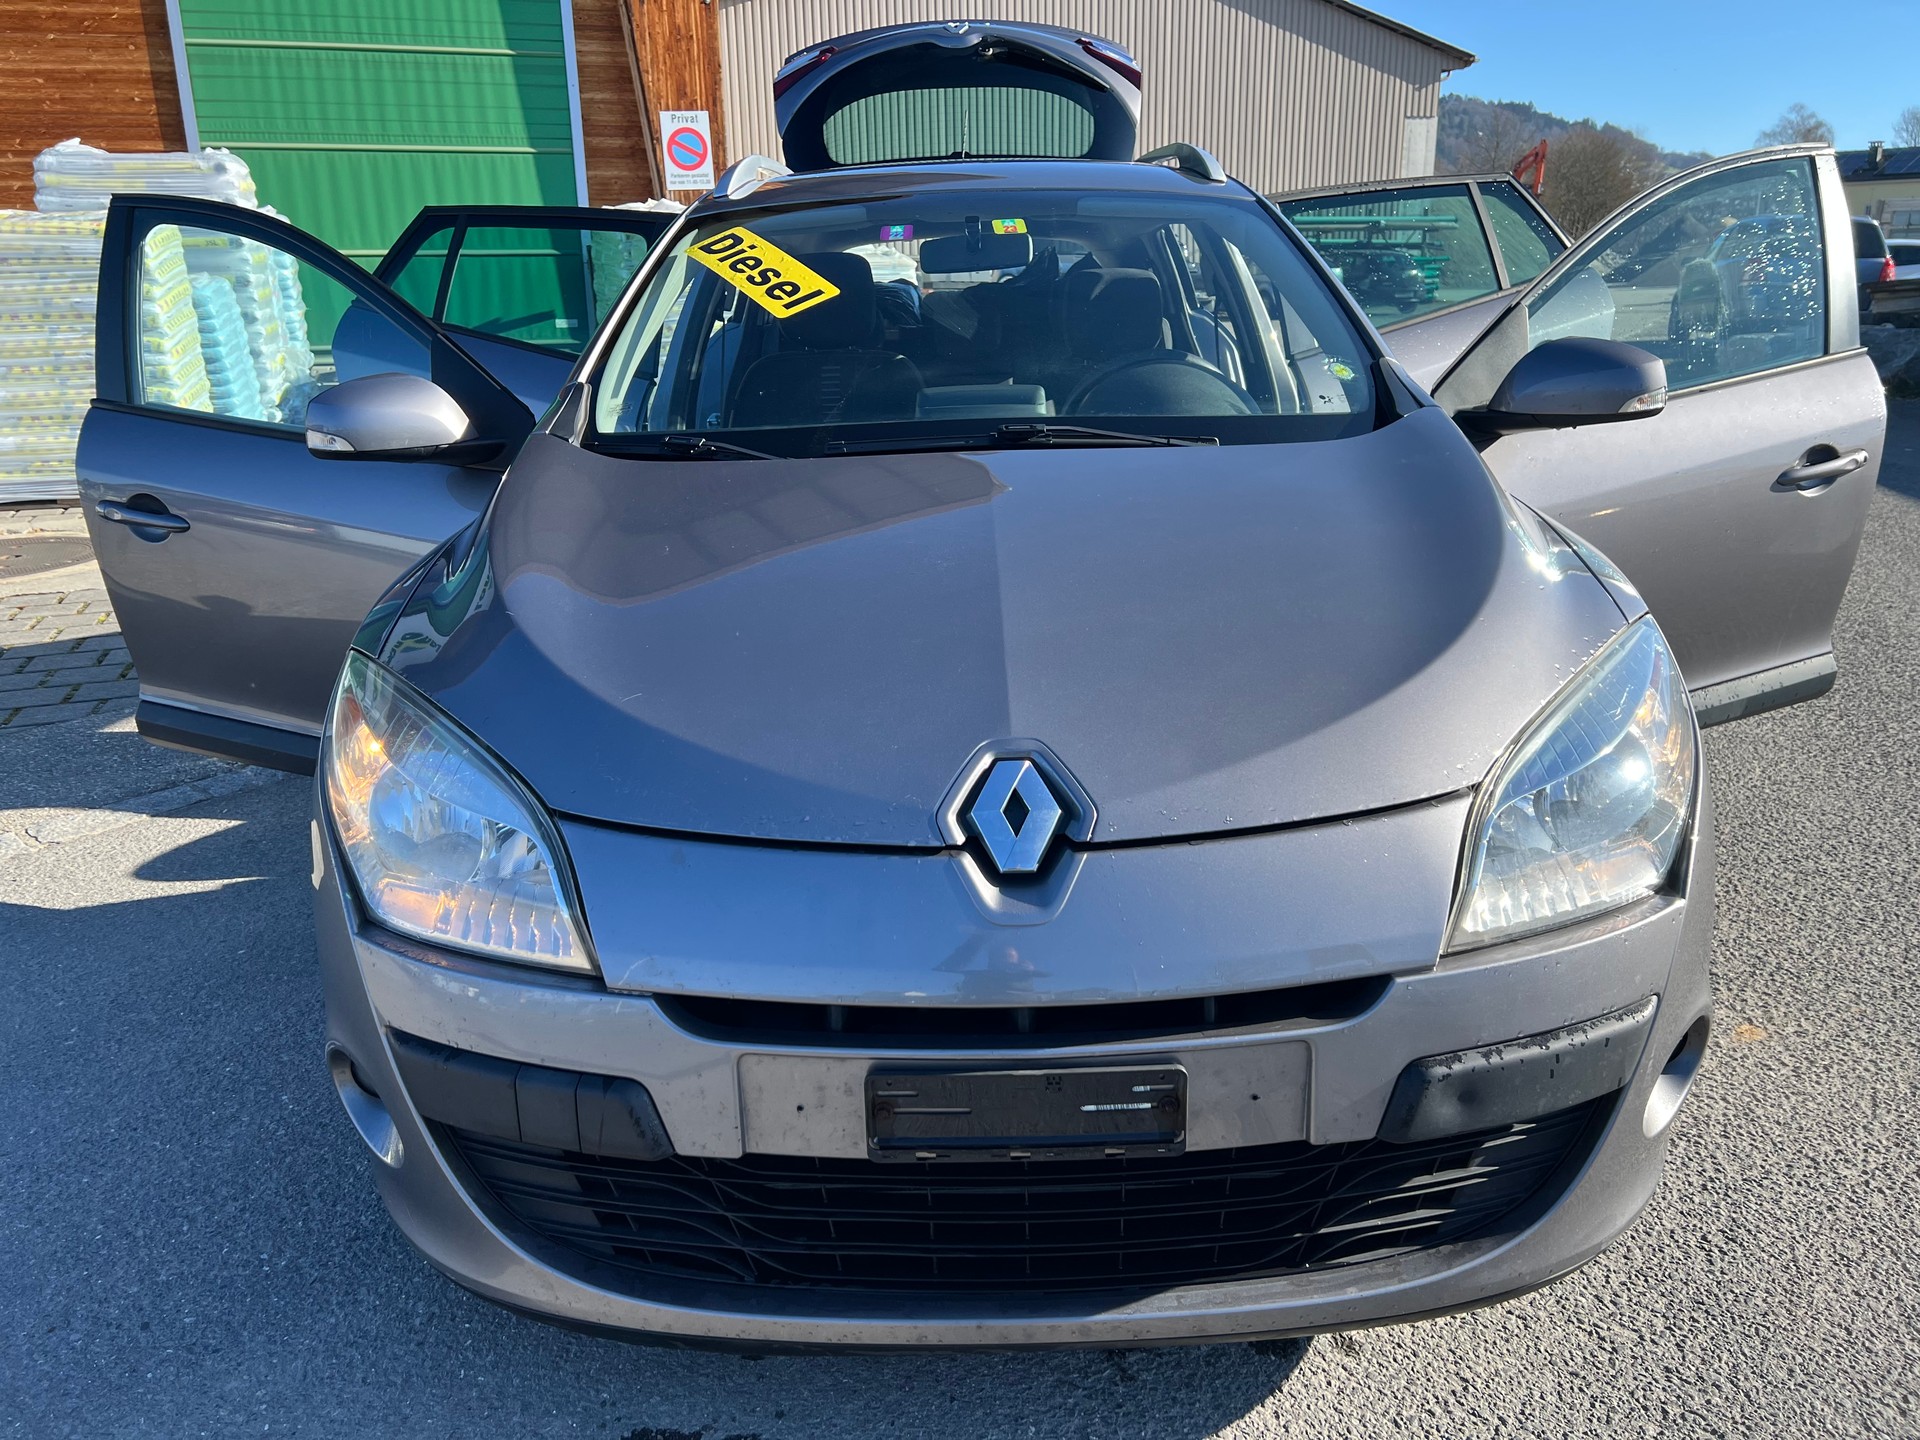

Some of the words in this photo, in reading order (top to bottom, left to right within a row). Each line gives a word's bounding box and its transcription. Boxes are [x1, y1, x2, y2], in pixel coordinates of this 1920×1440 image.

[671, 113, 699, 123] Privat
[1003, 225, 1018, 233] 23
[698, 232, 825, 310] Diesel
